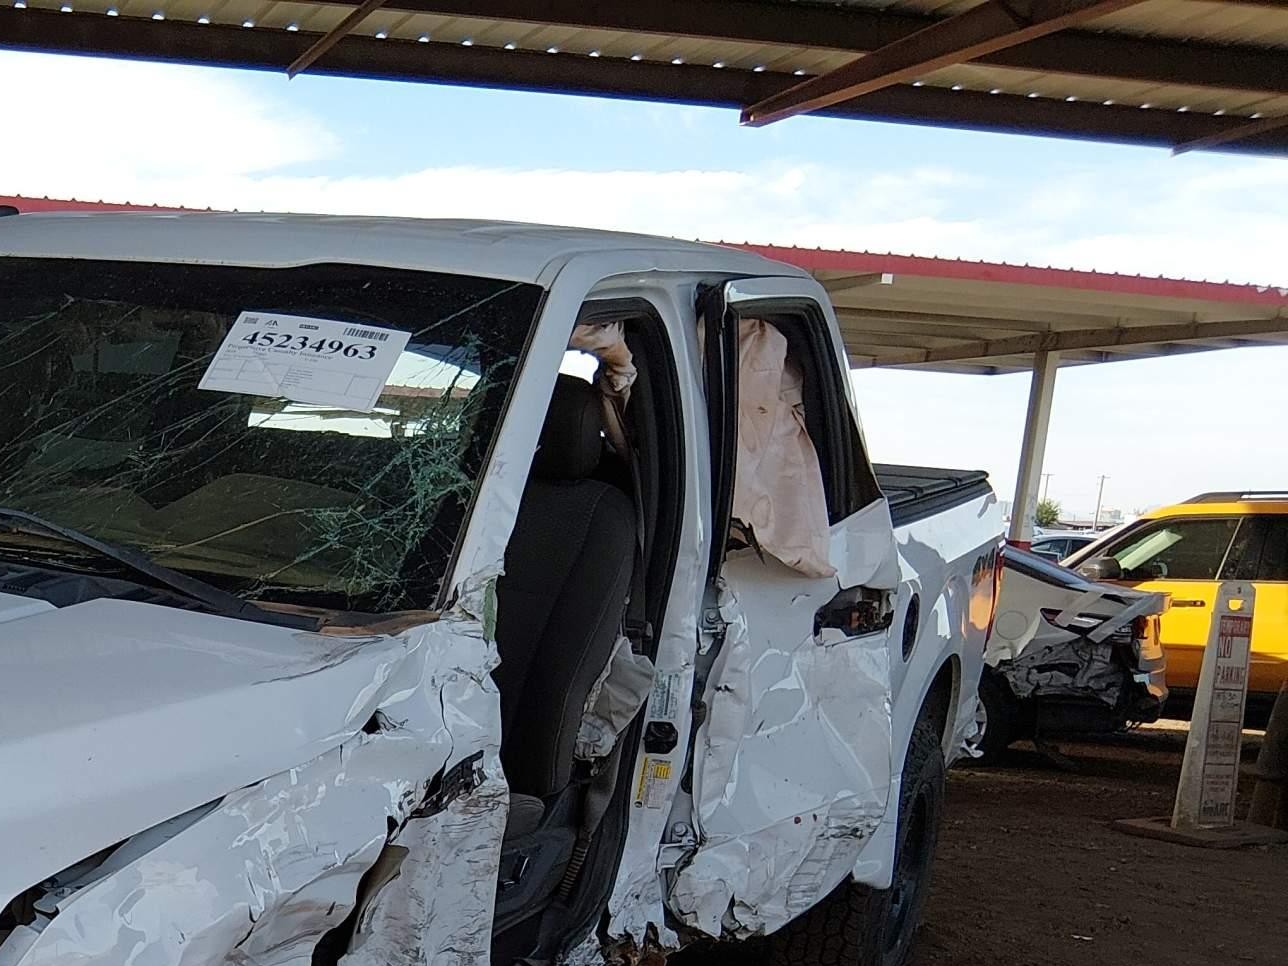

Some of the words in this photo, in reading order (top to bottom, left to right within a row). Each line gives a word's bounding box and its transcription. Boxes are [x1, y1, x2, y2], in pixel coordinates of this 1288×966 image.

[242, 331, 378, 361] 45234963
[1217, 635, 1232, 659] NO
[1216, 665, 1246, 685] PARKING
